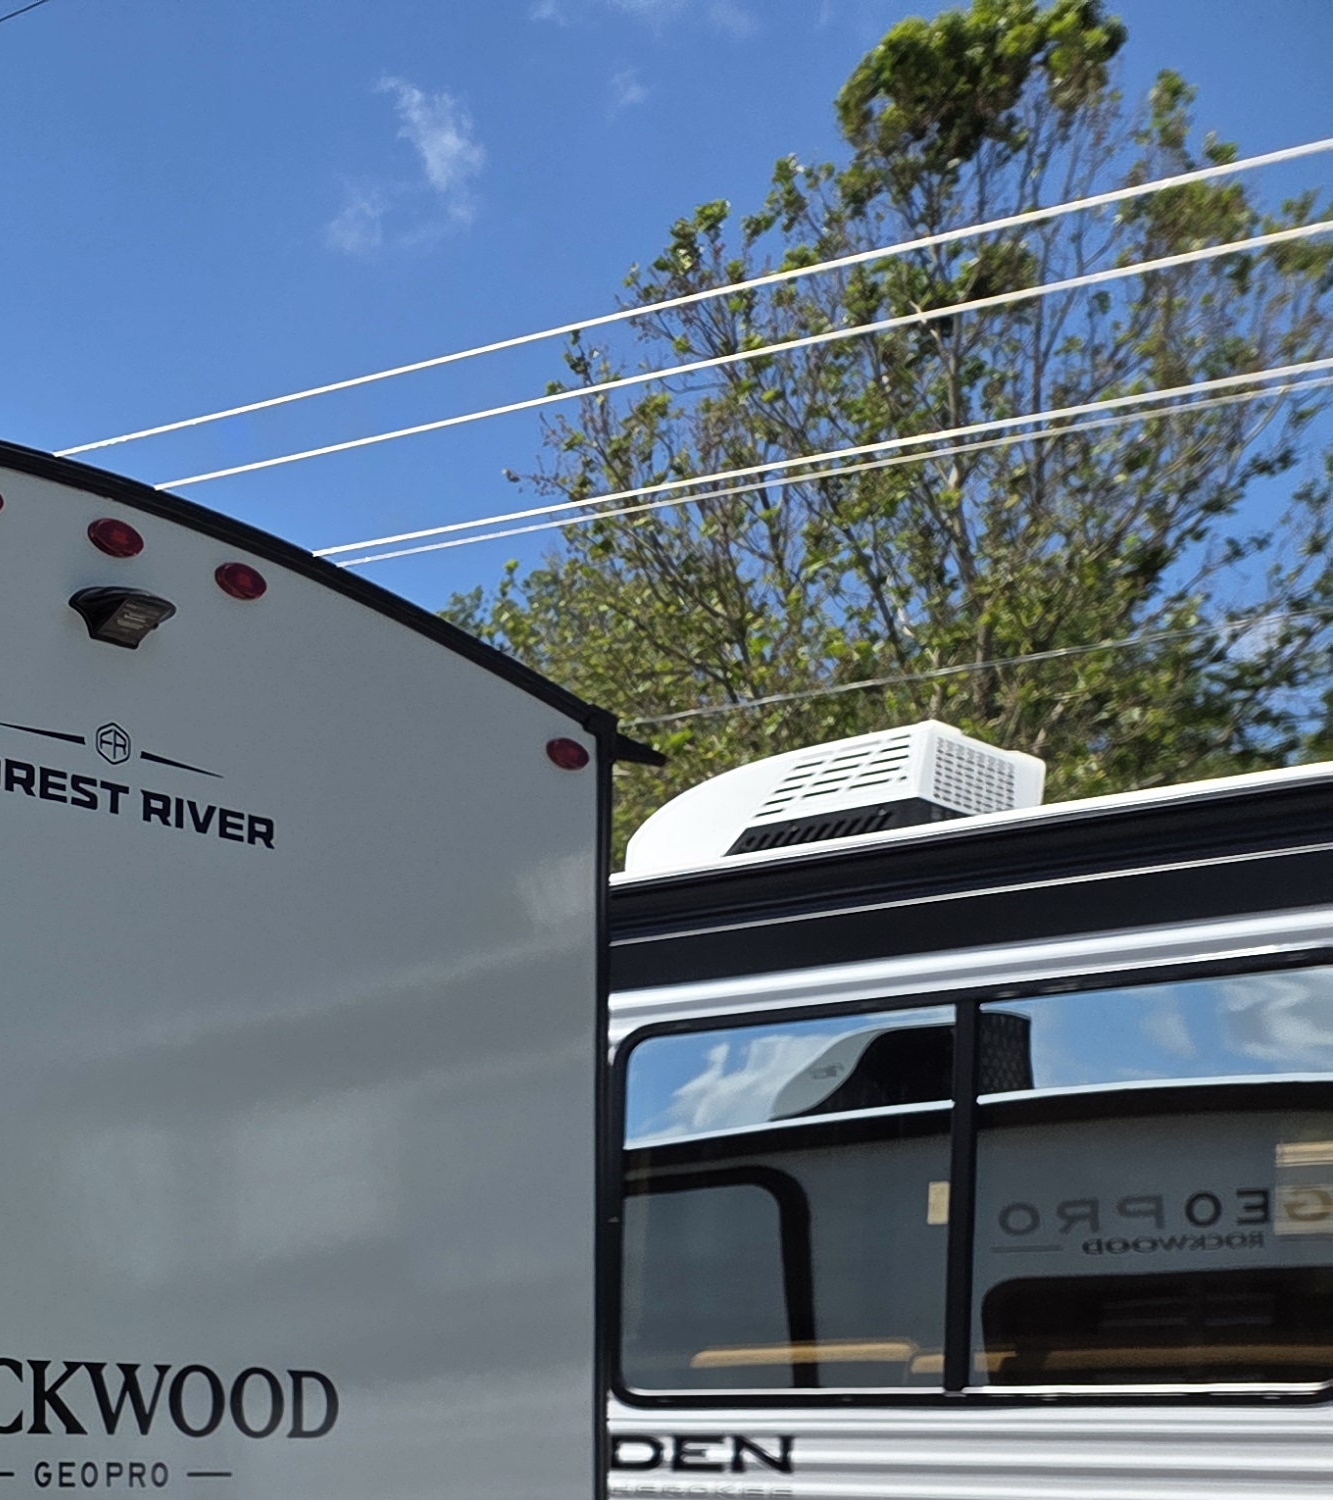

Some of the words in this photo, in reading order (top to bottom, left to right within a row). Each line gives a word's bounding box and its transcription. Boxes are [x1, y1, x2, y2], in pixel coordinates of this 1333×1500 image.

[140, 789, 275, 850] RIVER
[611, 1433, 794, 1474] DEN
[34, 1462, 169, 1488] GEOPRO
